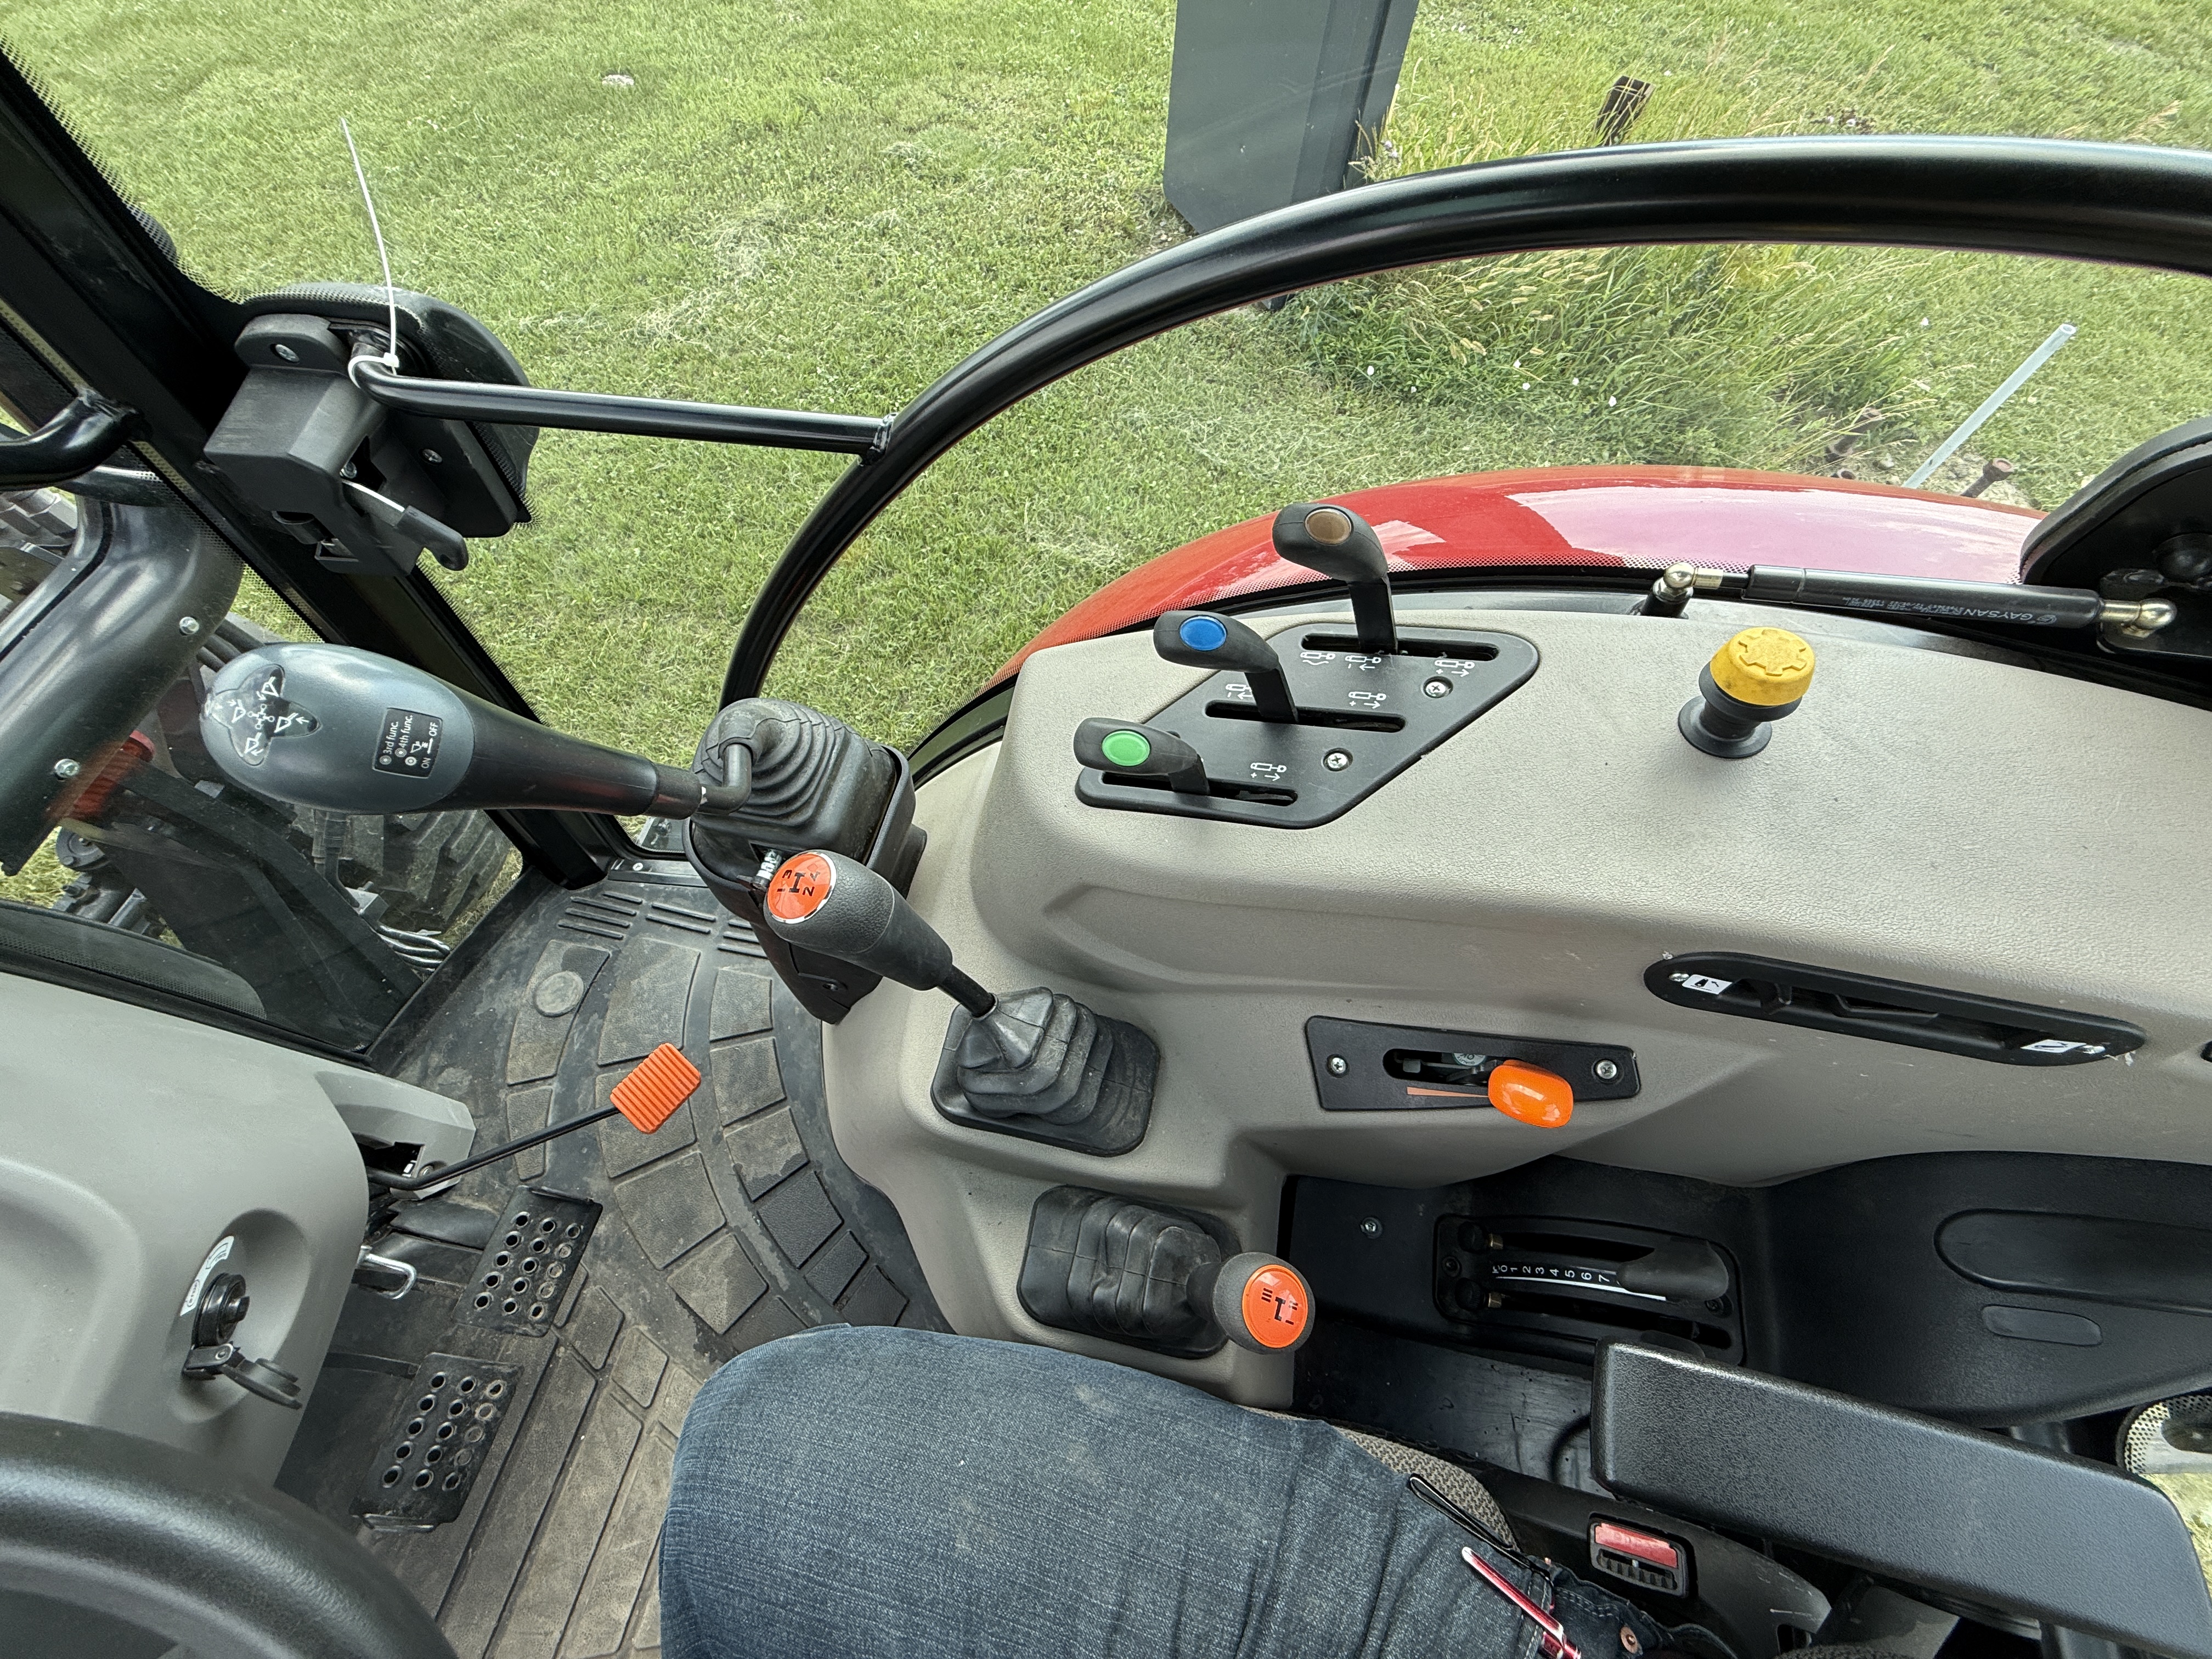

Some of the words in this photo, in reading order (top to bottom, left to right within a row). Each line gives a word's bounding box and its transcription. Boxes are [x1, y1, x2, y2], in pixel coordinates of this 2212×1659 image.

[1963, 608, 2033, 620] GAYSAN
[400, 715, 413, 733] func.
[386, 721, 399, 741] func.
[383, 741, 394, 754] 3rd
[398, 735, 410, 748] 4th
[421, 757, 432, 769] ON
[428, 721, 438, 736] OFF
[782, 870, 792, 879] 3
[802, 886, 815, 897] 2
[1522, 1266, 1531, 1274] 2
[1549, 1268, 1560, 1277] 4
[1565, 1270, 1575, 1278] 5
[1581, 1272, 1592, 1280] 6
[1598, 1274, 1610, 1283] 7
